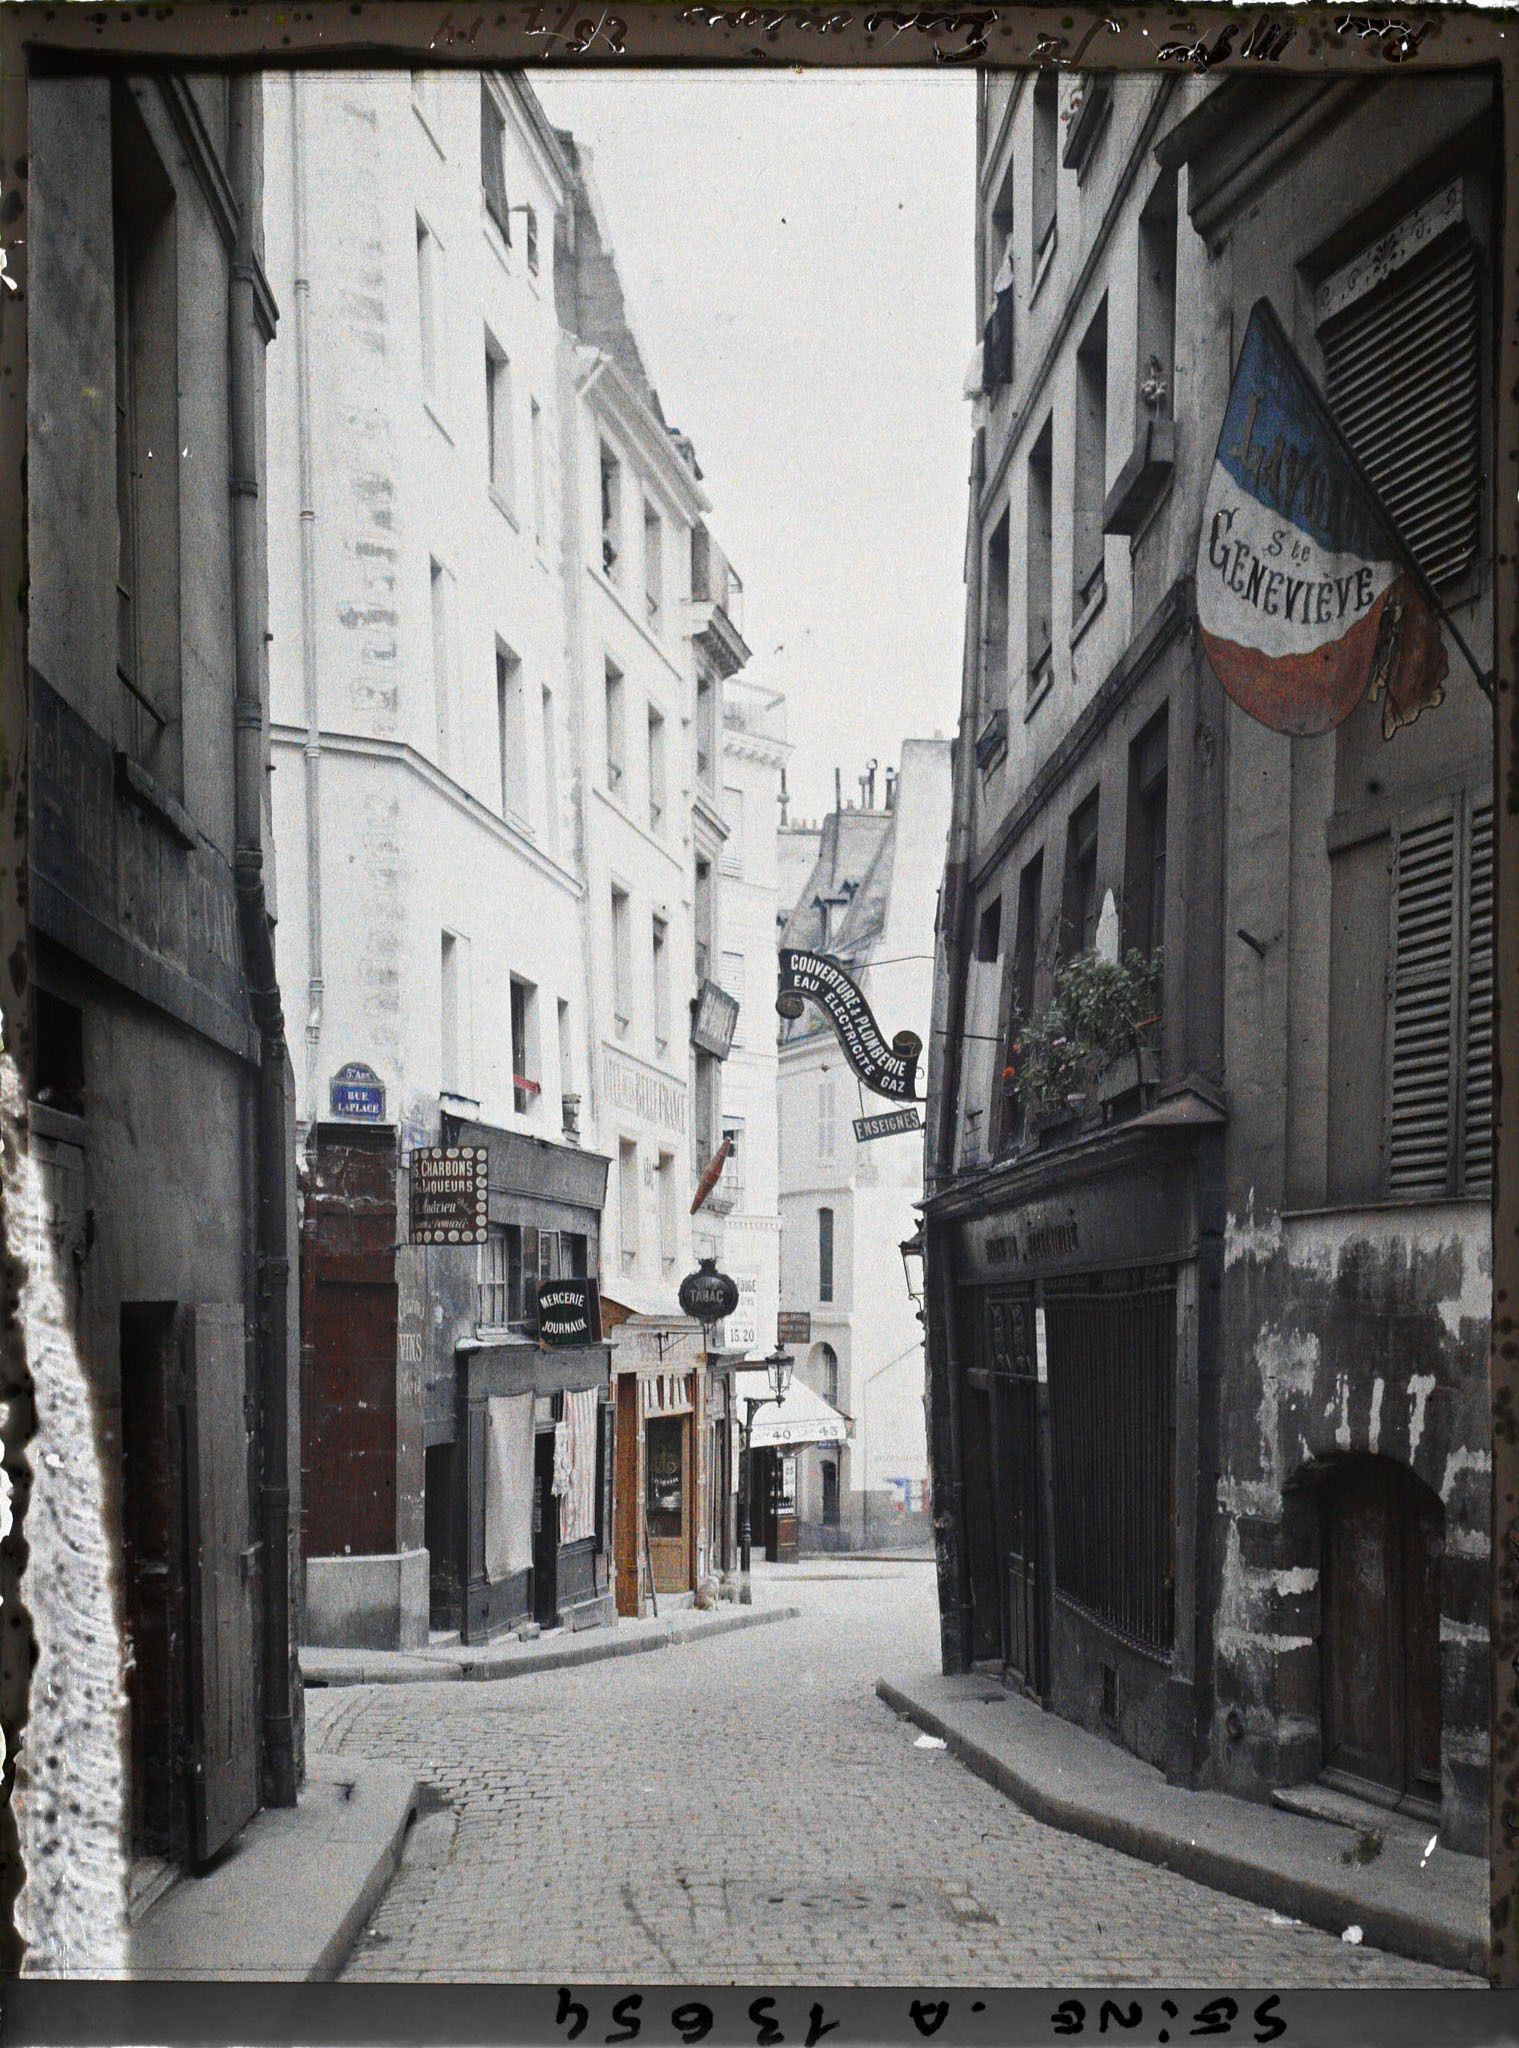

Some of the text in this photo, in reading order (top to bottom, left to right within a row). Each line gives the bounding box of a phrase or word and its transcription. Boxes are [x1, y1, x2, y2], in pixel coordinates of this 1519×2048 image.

[790, 953, 862, 1011] COUVERTURE
[854, 1013, 908, 1078] PLOMBERIE
[793, 974, 906, 1094] EAU ELECTRICITE GAZ
[338, 1102, 380, 1114] LAPLACE
[854, 1110, 921, 1140] ENSEIGNES
[421, 1159, 474, 1177] CHARBONS
[421, 1179, 474, 1195] LIQUEURS
[539, 1291, 586, 1310] MERCERIE
[689, 1288, 725, 1305] TABAC
[541, 1316, 588, 1335] JOURNAUX
[398, 1333, 423, 1362] VINS
[772, 1429, 792, 1441] 40
[555, 1986, 842, 2048] 13654
